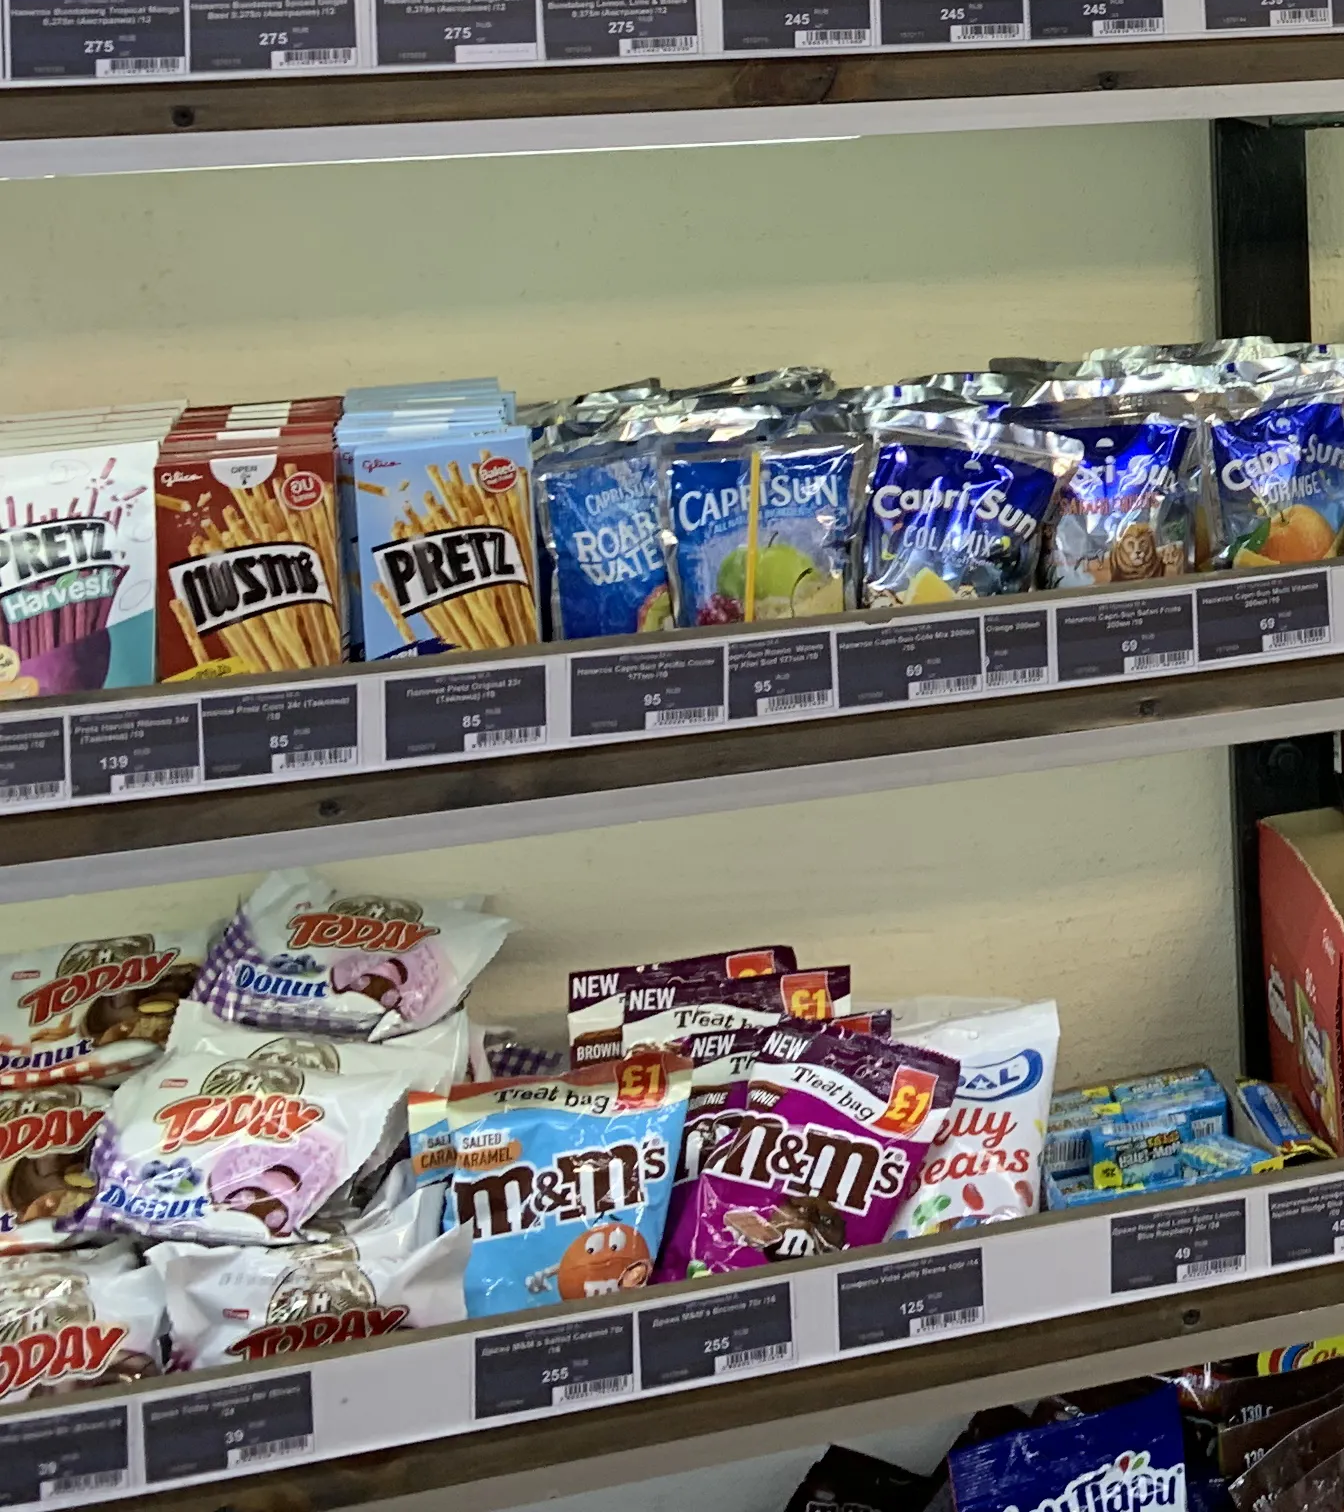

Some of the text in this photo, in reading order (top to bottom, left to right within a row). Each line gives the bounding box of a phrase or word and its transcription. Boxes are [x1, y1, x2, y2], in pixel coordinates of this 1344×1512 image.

[784, 13, 811, 26] 245
[940, 8, 965, 21] 245
[1082, 3, 1107, 16] 245
[444, 27, 472, 39] 275
[608, 22, 634, 34] 275
[84, 40, 114, 53] 275
[259, 33, 288, 46] 275
[872, 483, 1039, 540] Capri-Sun
[0, 517, 111, 580] PRETZ
[396, 529, 516, 606] PRETZ
[2, 568, 111, 623] Harvest
[754, 680, 772, 693] 95
[643, 693, 662, 706] 95
[462, 714, 481, 728] 85
[269, 734, 289, 748] 85
[99, 756, 129, 770] 139
[288, 911, 440, 952] TODAY
[19, 948, 180, 1025] TODAY
[235, 963, 332, 999] Donut
[572, 973, 619, 999] NEW
[628, 986, 676, 1011] NEW
[691, 1032, 736, 1059] NEW
[763, 1030, 809, 1062] NEW
[493, 1084, 612, 1114] Treat bag
[155, 1092, 326, 1152] TODAY
[462, 1132, 503, 1149] SALTED
[701, 1109, 910, 1217] m&m's
[455, 1139, 667, 1240] m&m's
[100, 1183, 209, 1221] Donut
[1175, 1247, 1190, 1259] 49
[898, 1299, 925, 1315] 125
[228, 1303, 410, 1360] TODAY
[703, 1336, 731, 1354] 255
[541, 1365, 569, 1384] 255
